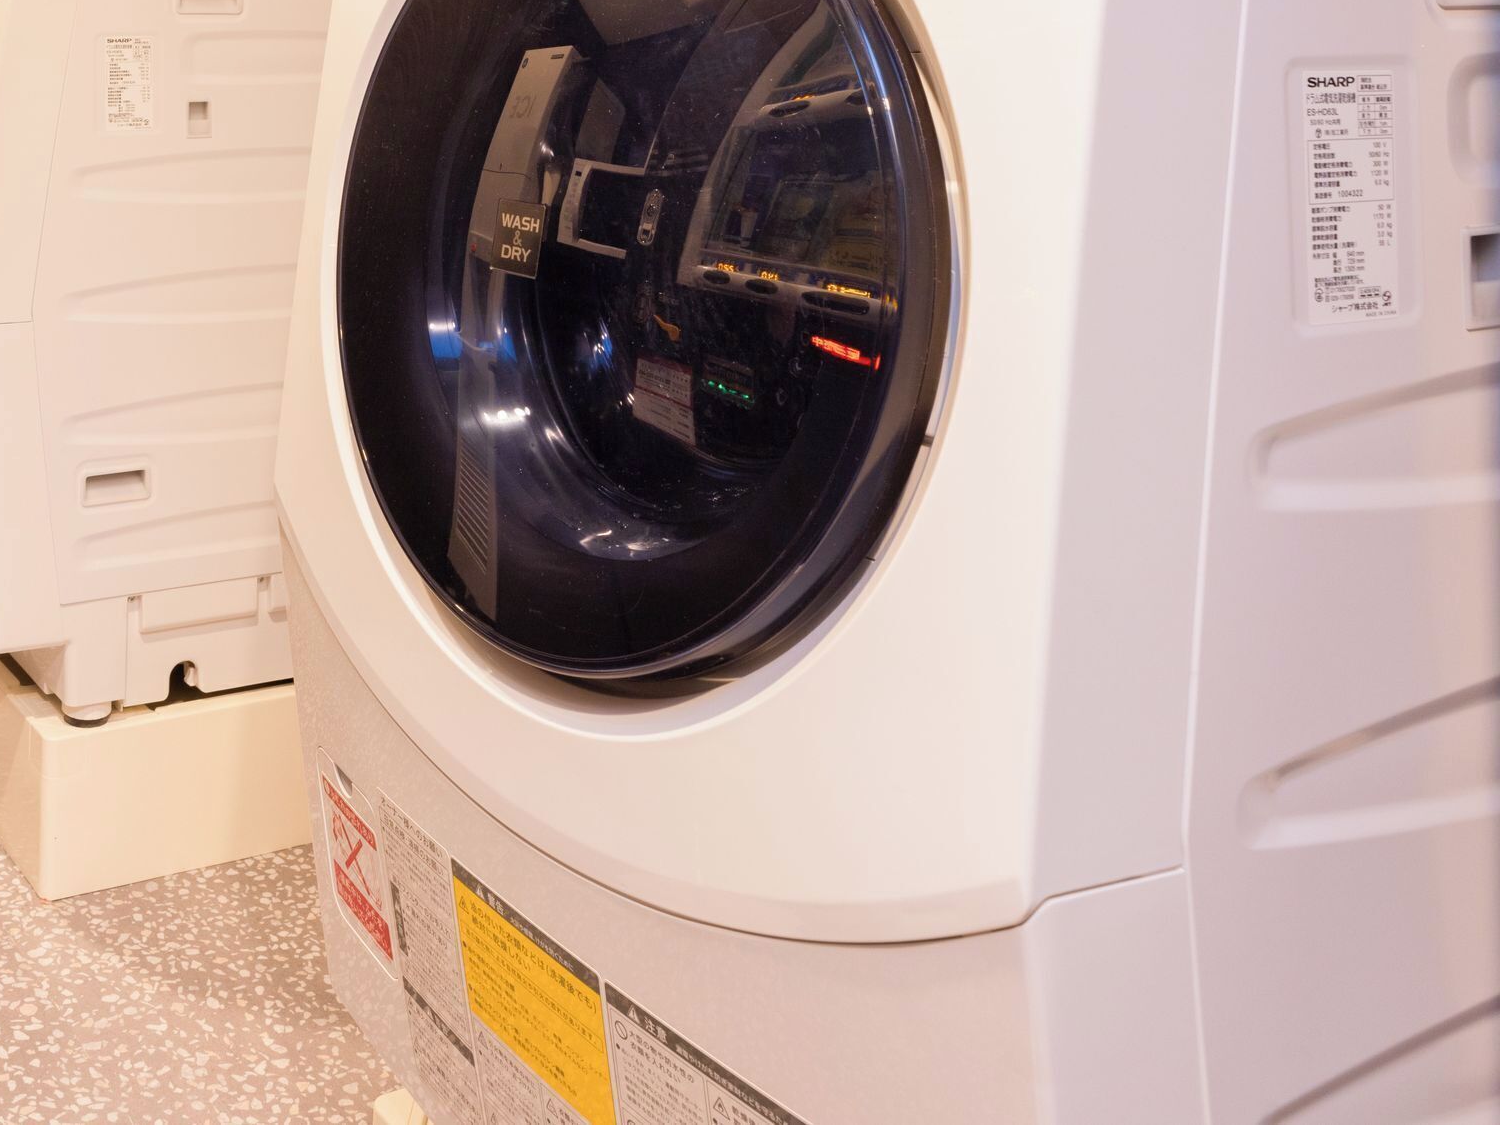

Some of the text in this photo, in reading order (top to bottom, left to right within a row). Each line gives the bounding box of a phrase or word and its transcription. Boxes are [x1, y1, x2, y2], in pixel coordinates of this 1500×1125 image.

[1307, 76, 1355, 88] SHARP
[502, 212, 540, 233] WASH
[512, 230, 522, 246] &
[501, 244, 531, 263] DRY
[1332, 301, 1379, 313] シャープ株式会社
[643, 1014, 669, 1046] 注意
